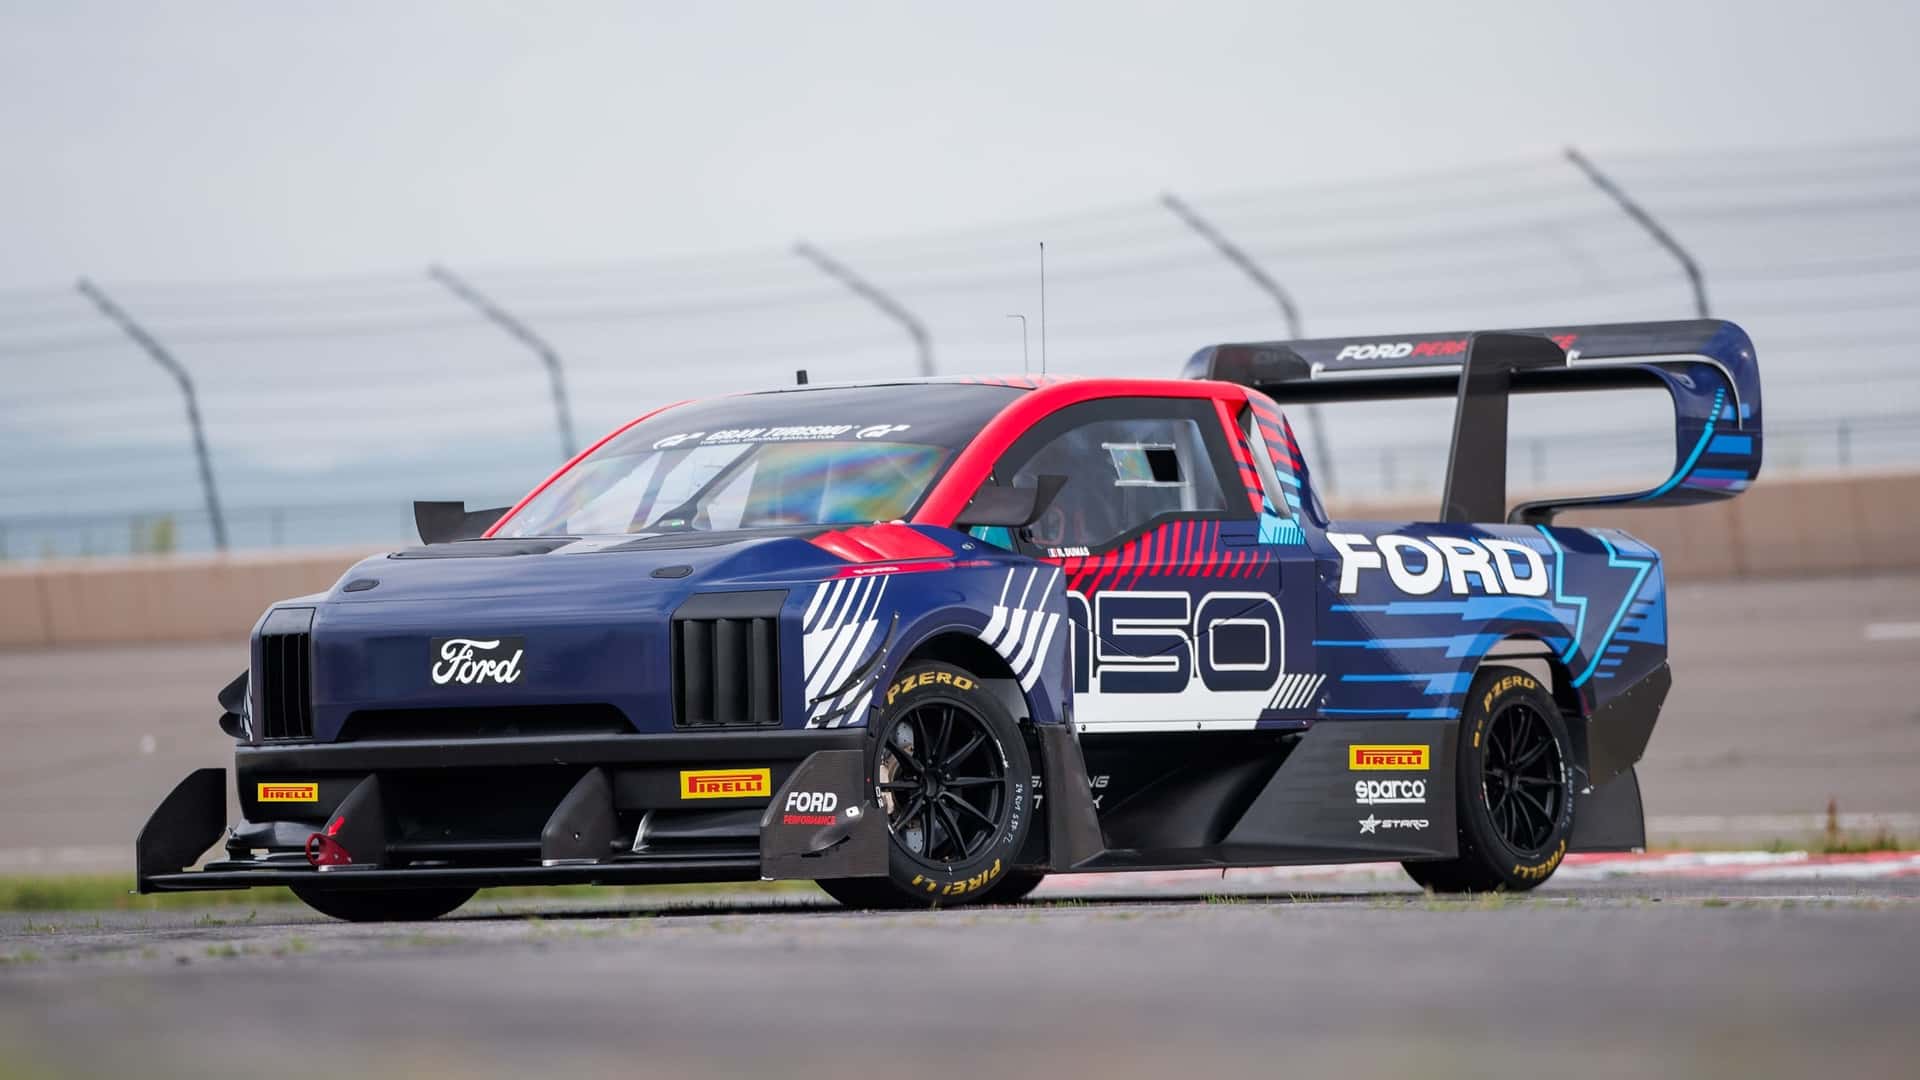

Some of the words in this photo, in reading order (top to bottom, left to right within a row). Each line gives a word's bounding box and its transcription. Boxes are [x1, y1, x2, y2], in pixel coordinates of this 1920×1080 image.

[1336, 342, 1413, 361] FORD
[705, 428, 767, 441] GRAN
[763, 424, 852, 437] TURISMO
[1326, 531, 1549, 597] FORD
[431, 639, 523, 684] Ford
[1356, 749, 1423, 765] PIRELLI
[263, 786, 313, 799] PIRELLI
[688, 774, 763, 794] PIRELLI
[1355, 780, 1427, 804] sparco
[784, 791, 838, 812] FORD
[783, 815, 837, 825] PERFORMANCE
[1381, 818, 1430, 831] STARD
[1513, 839, 1566, 879] PIRELLI
